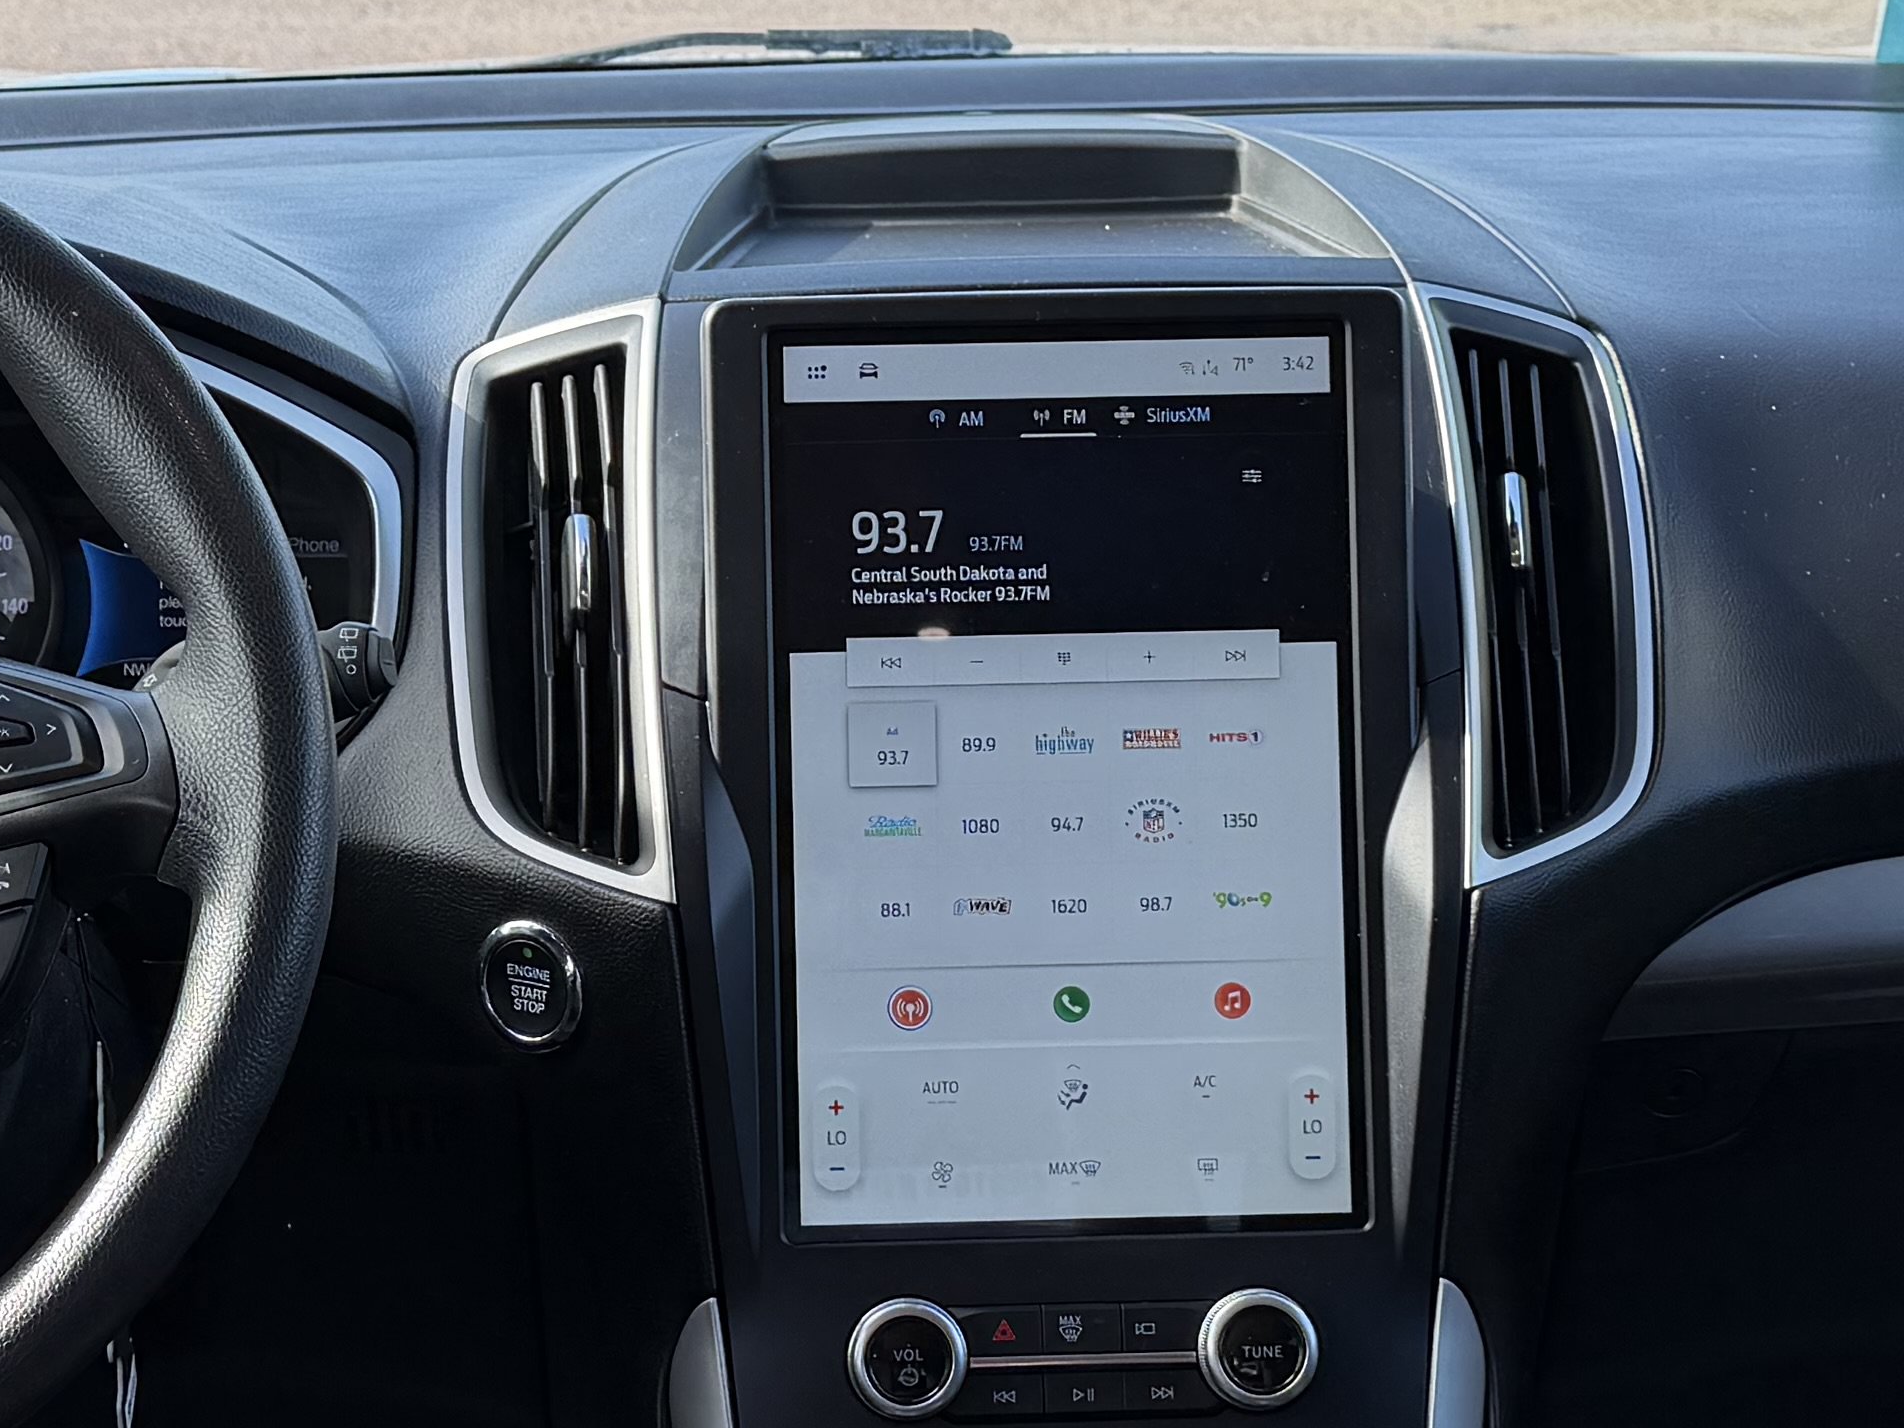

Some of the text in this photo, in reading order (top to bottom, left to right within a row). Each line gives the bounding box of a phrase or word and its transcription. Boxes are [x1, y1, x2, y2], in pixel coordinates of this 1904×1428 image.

[1233, 355, 1314, 373] 71° 3:42
[959, 405, 1211, 427] AM FM SiriusXM
[851, 509, 1023, 555] 93.7 93.7FM
[289, 538, 339, 553] Phone
[851, 563, 1048, 585] Central South Dakota and
[852, 585, 1051, 606] Nebraska's Rocker 93.7FM
[2, 597, 29, 614] 140
[962, 737, 997, 752] 89.9
[1035, 732, 1095, 755] highway
[1209, 732, 1248, 743] HITS
[877, 750, 909, 766] 93.7
[962, 818, 1000, 834] 1080
[1051, 817, 1084, 832] 94.7
[1223, 813, 1258, 828] 1350
[968, 900, 1008, 913] WAVE
[1051, 899, 1087, 914] 1620
[1140, 896, 1173, 912] 98.7
[1259, 891, 1273, 909] 9
[880, 902, 911, 917] 88.1
[506, 963, 551, 982] ENGINE
[511, 985, 547, 1002] START
[513, 998, 545, 1014] STOP
[922, 1080, 959, 1095] AUTO
[1193, 1074, 1217, 1090] A/C
[1302, 1119, 1323, 1135] LO
[827, 1130, 847, 1146] LO
[1048, 1161, 1078, 1176] MAX
[1059, 1315, 1082, 1326] MAX
[893, 1348, 923, 1362] VOL
[1243, 1344, 1284, 1360] TUNE
